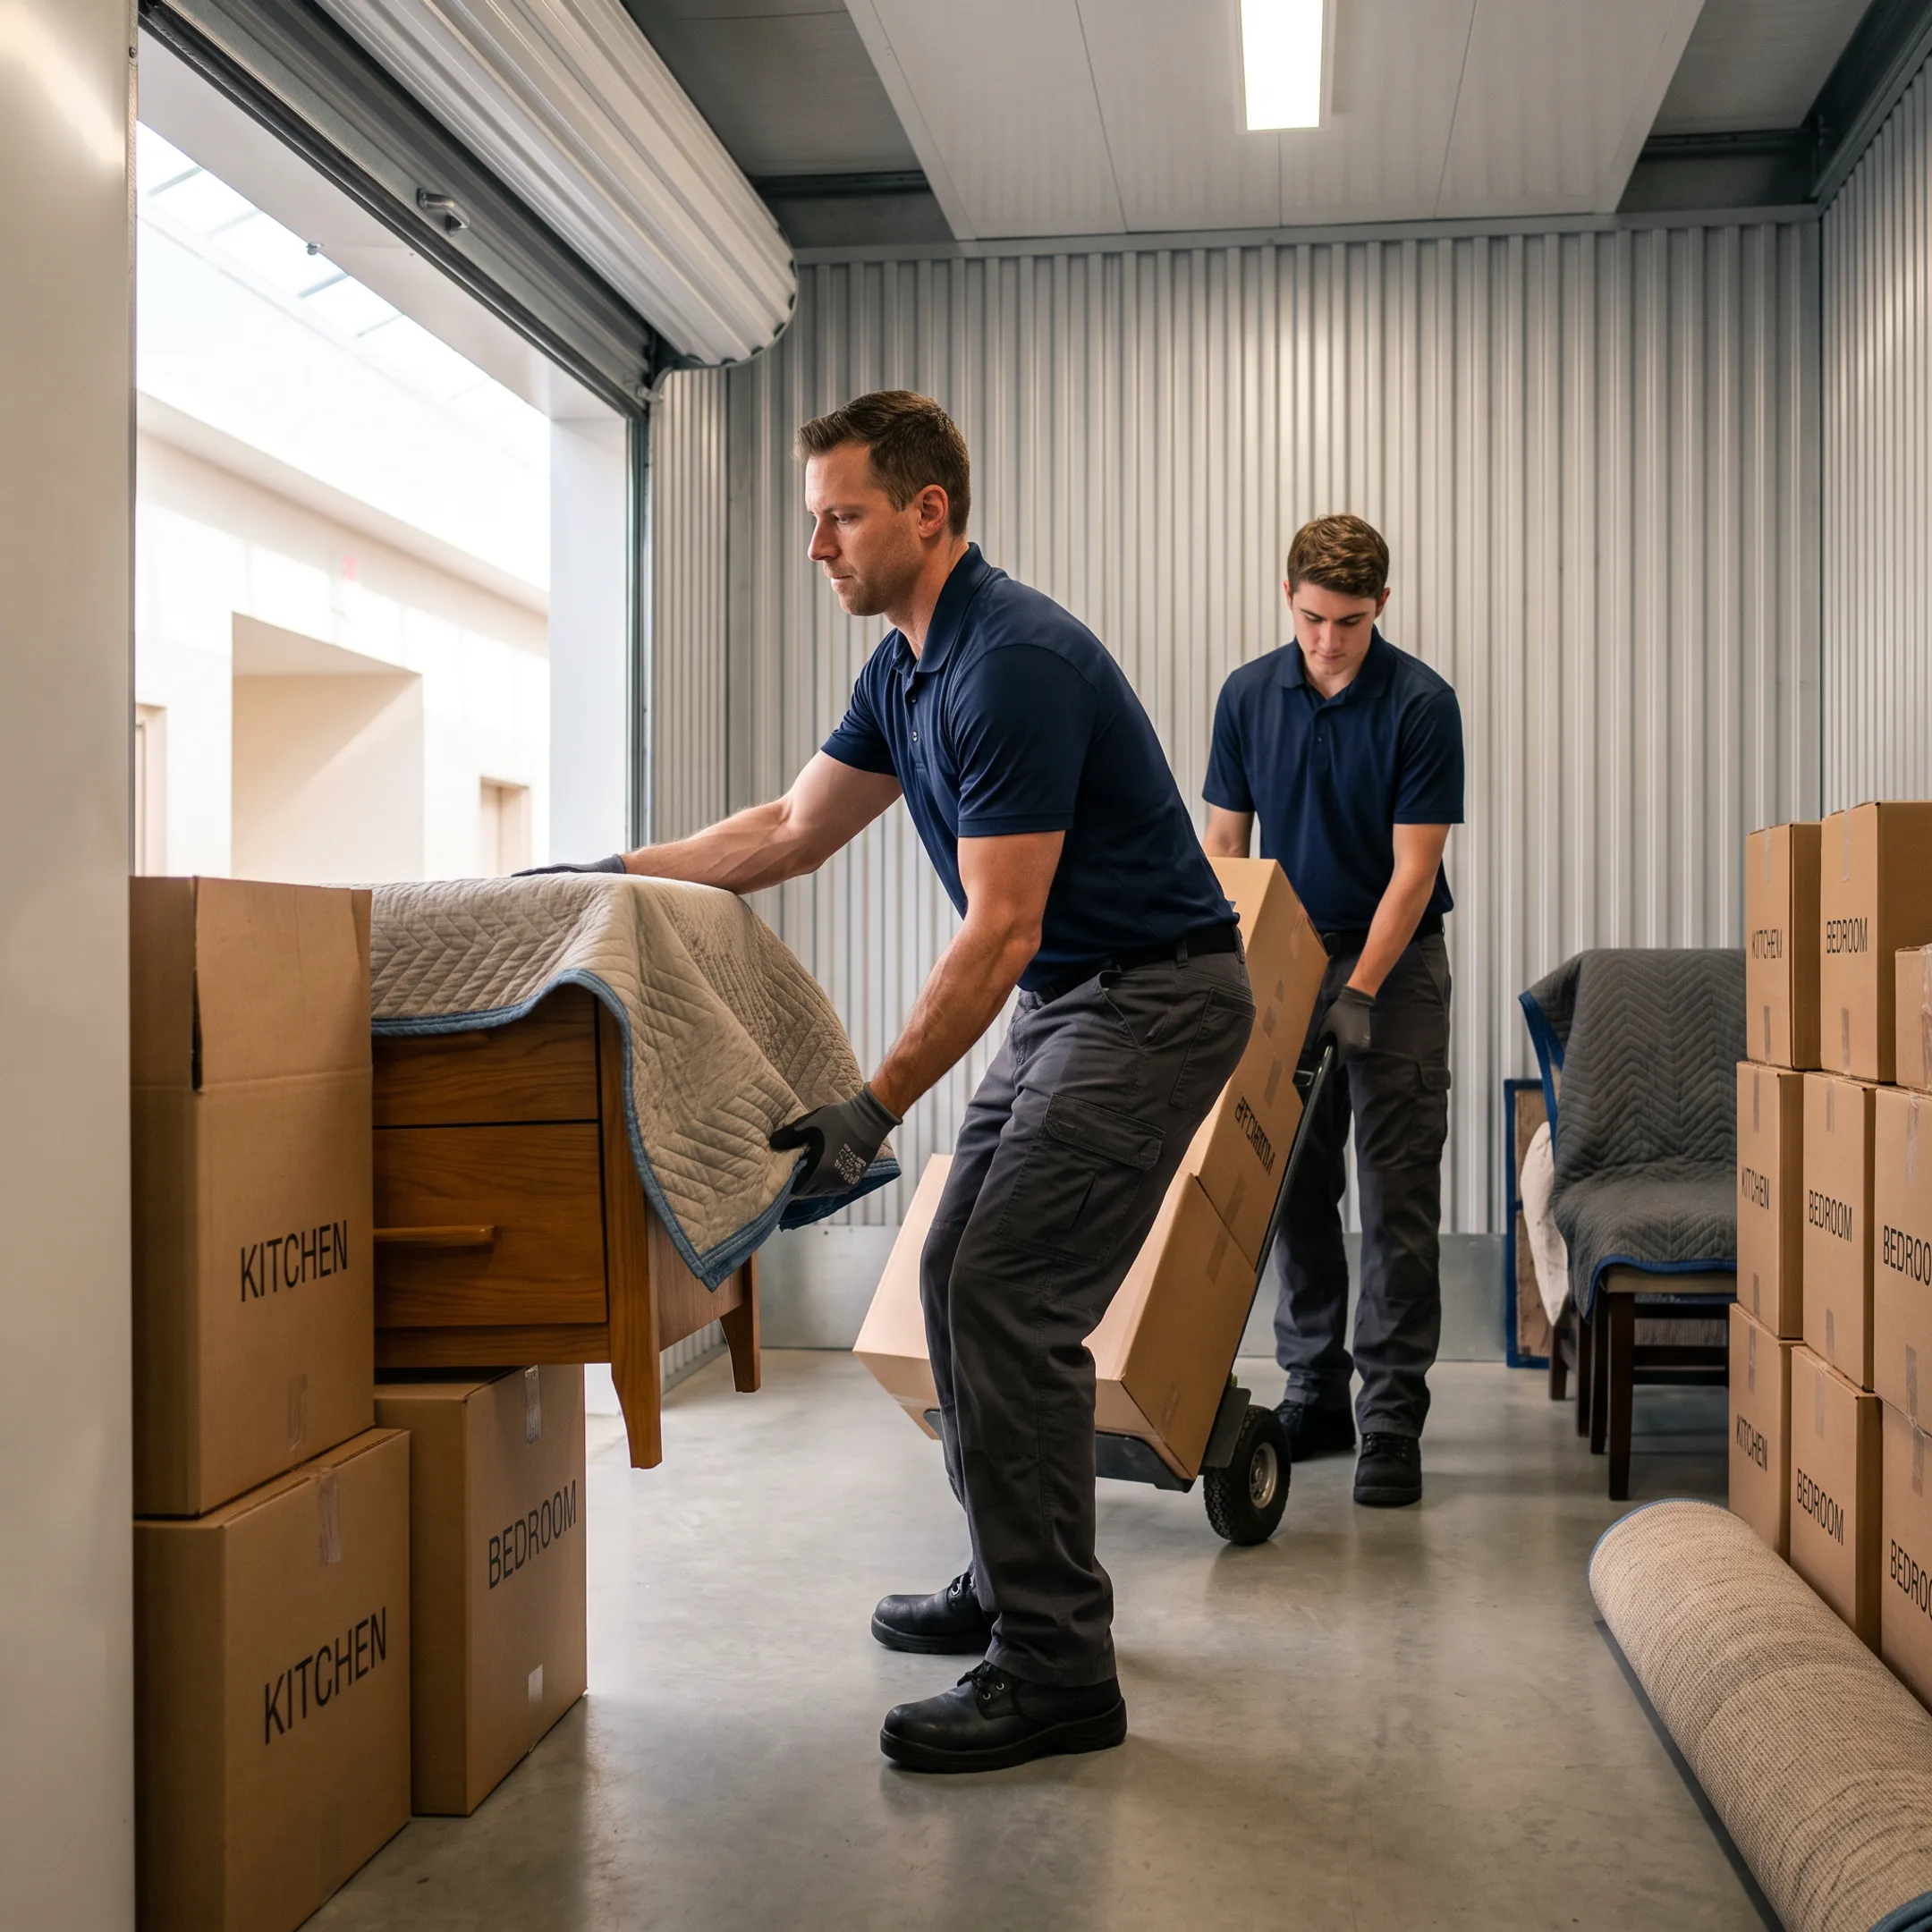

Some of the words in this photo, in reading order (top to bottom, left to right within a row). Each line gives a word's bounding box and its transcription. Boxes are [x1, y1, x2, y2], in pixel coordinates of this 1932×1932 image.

[1826, 917, 1868, 953] BEDROOM
[1741, 1165, 1769, 1210] KITCHEN
[1809, 1189, 1852, 1242] BEDROOM
[241, 1219, 349, 1302] KITCHEN
[1736, 1413, 1767, 1471] KITCHEN
[488, 1479, 576, 1590] BEDROOM
[1796, 1468, 1844, 1546] BEDROOM
[264, 1606, 387, 1747] KITCHEN
